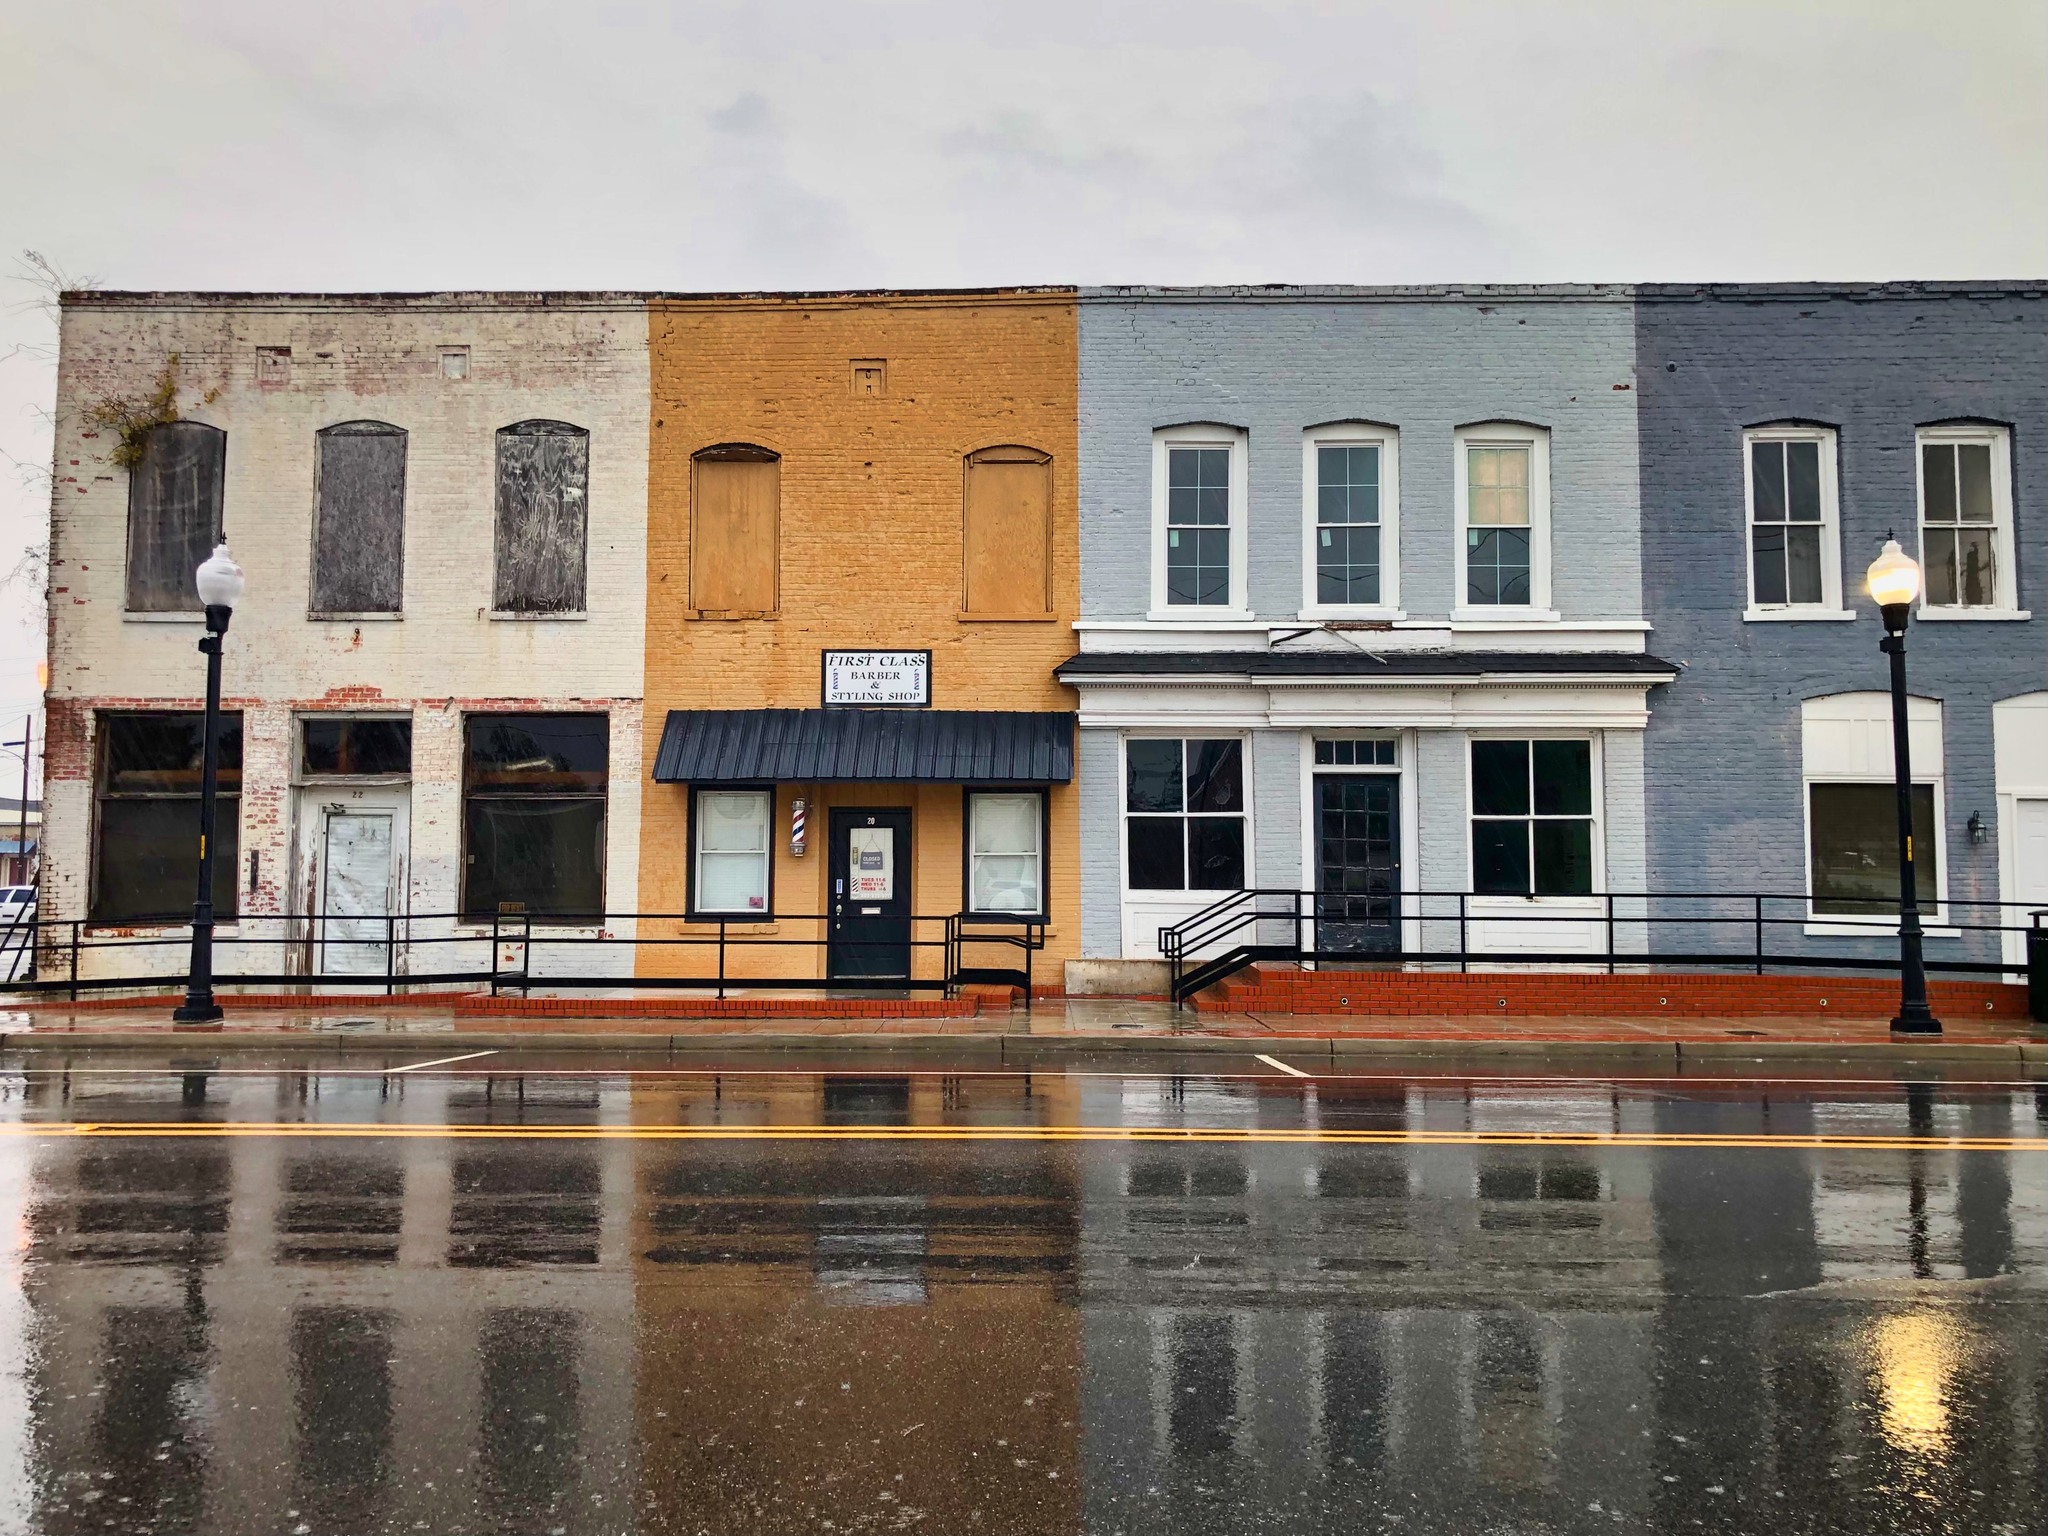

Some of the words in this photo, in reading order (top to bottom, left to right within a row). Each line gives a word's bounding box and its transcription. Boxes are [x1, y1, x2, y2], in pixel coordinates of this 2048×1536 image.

[828, 656, 875, 666] FIRST
[880, 656, 926, 666] CLASS
[851, 671, 901, 680] BARBER
[870, 681, 881, 690] &
[831, 692, 883, 701] STYLING
[888, 692, 920, 701] SHOP
[352, 791, 364, 799] 22
[867, 817, 876, 825] 20
